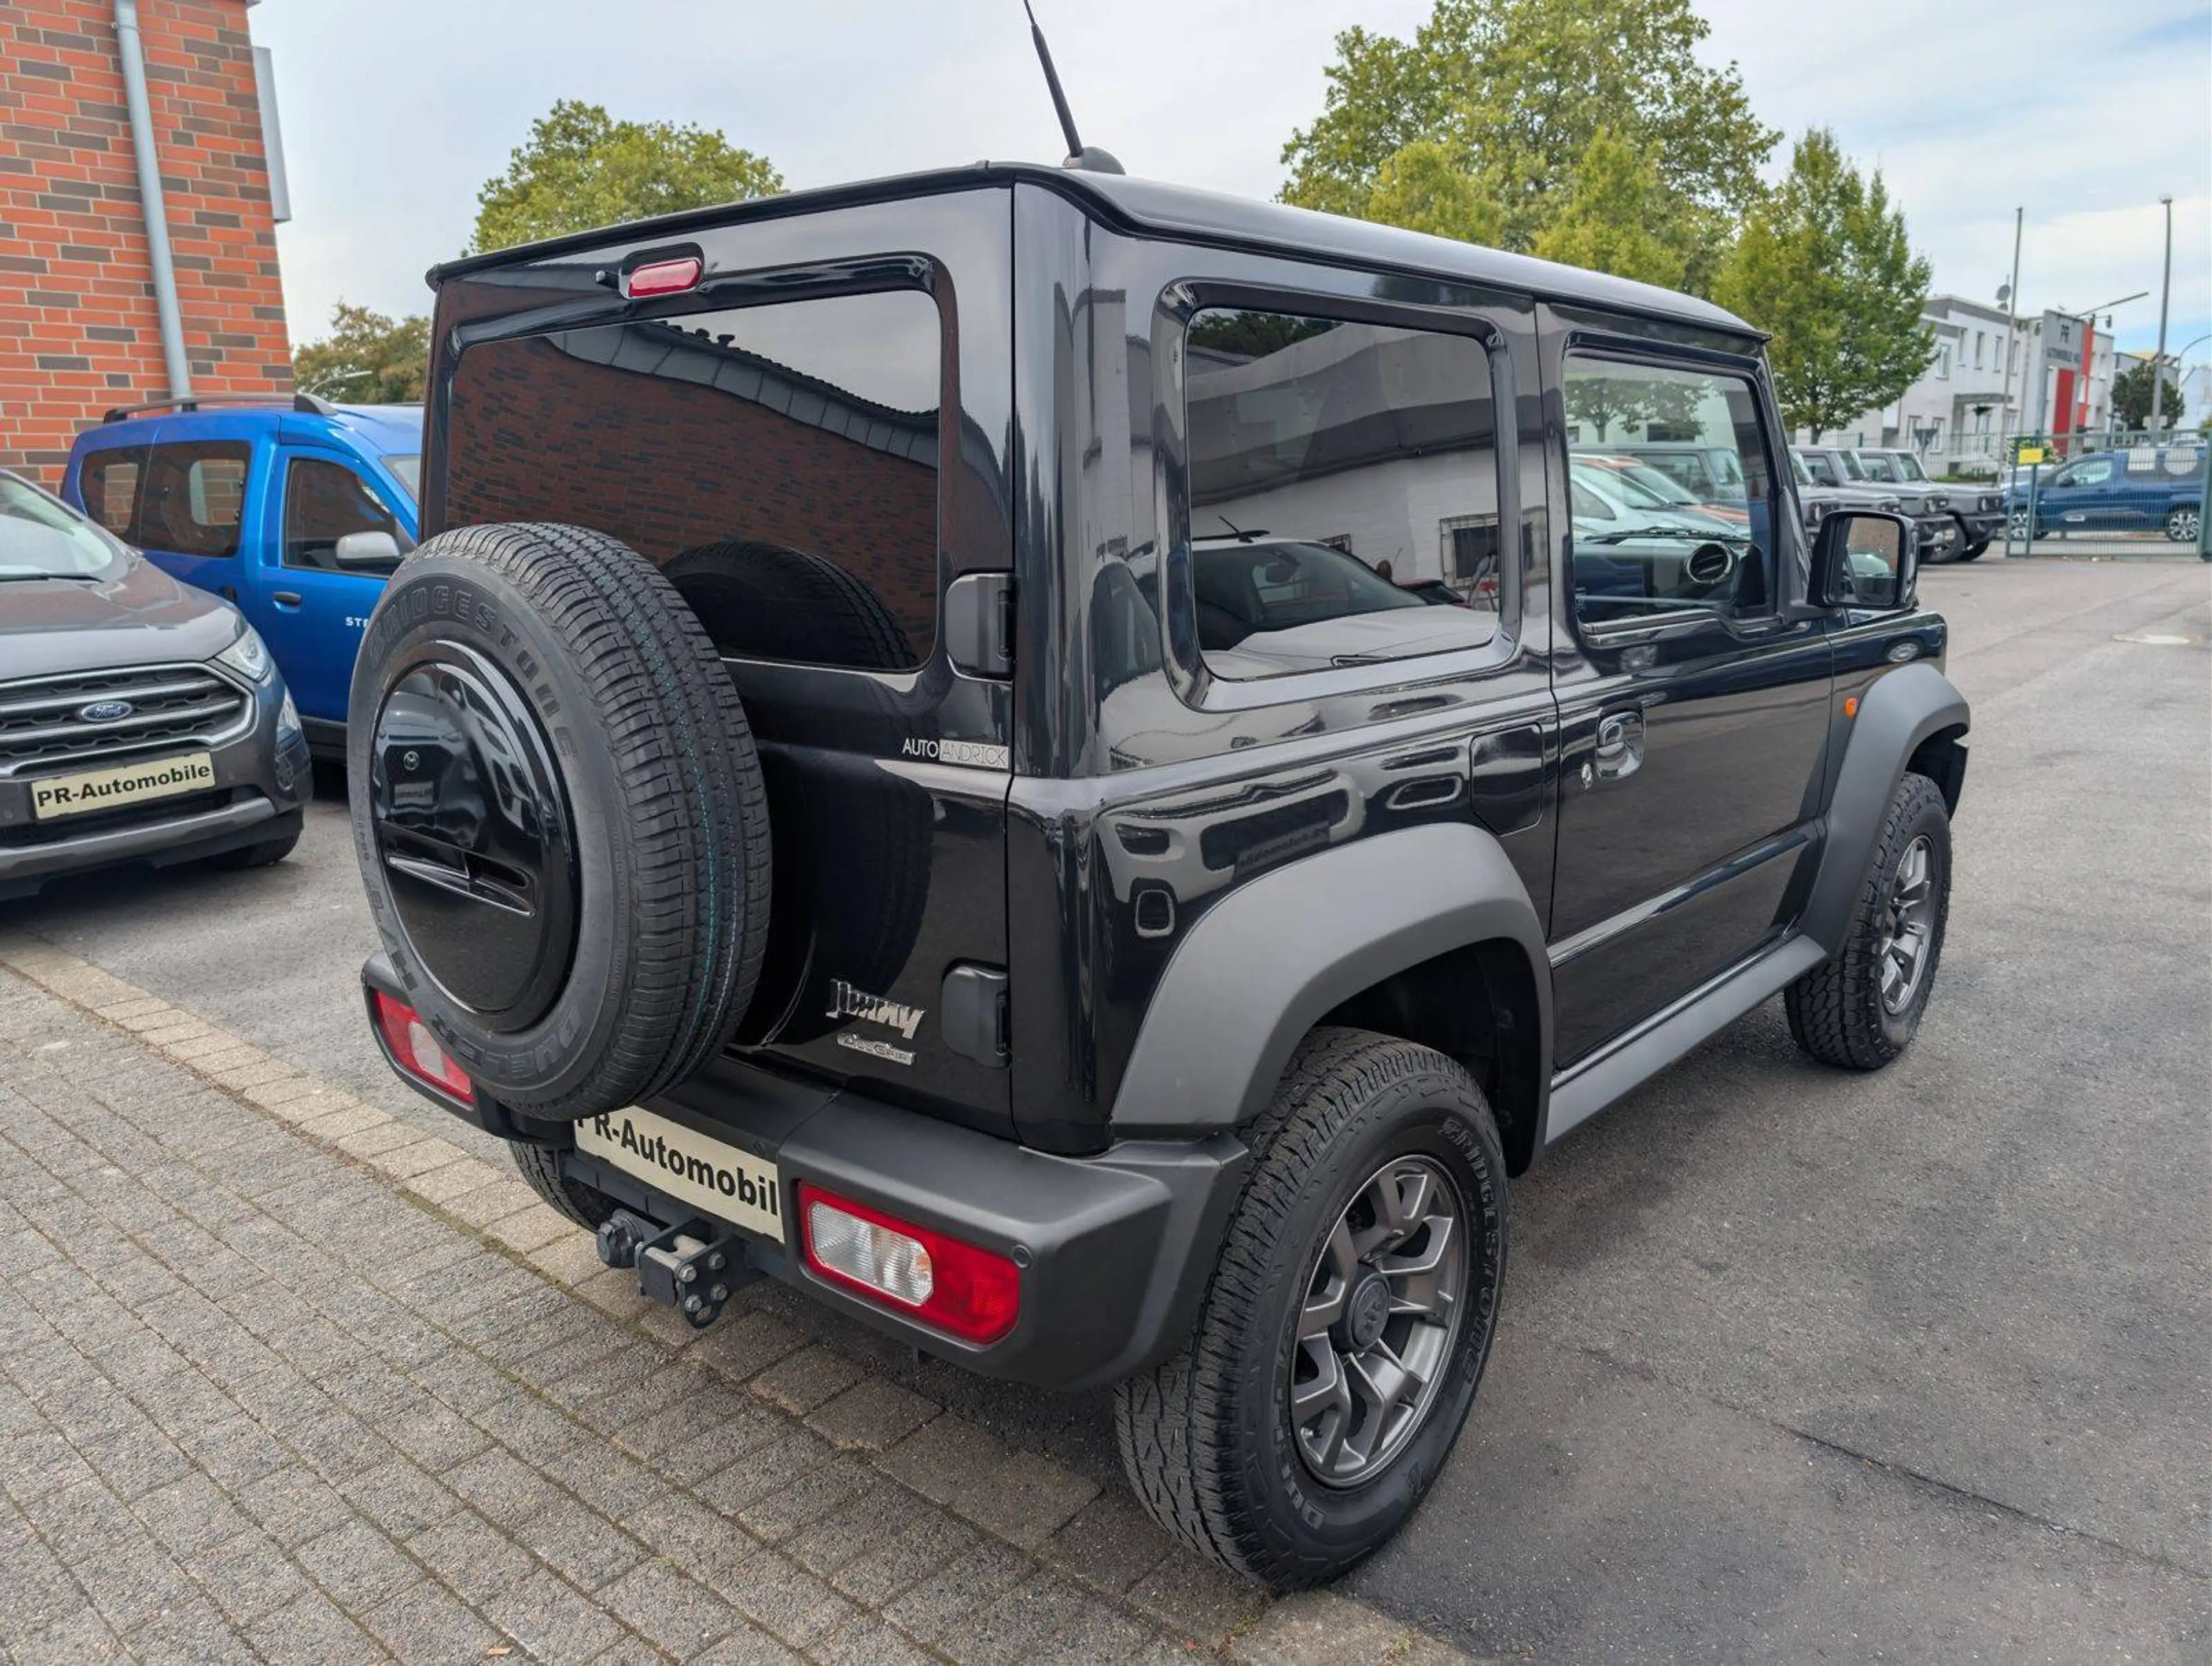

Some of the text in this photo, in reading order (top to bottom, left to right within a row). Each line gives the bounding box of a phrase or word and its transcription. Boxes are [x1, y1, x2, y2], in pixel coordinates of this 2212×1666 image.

[368, 584, 577, 758] BRIDGESTONE
[95, 704, 123, 717] Ford
[902, 738, 938, 758] AUTO
[37, 764, 211, 808] PR-Automobile
[578, 1112, 778, 1217] R-Automobil
